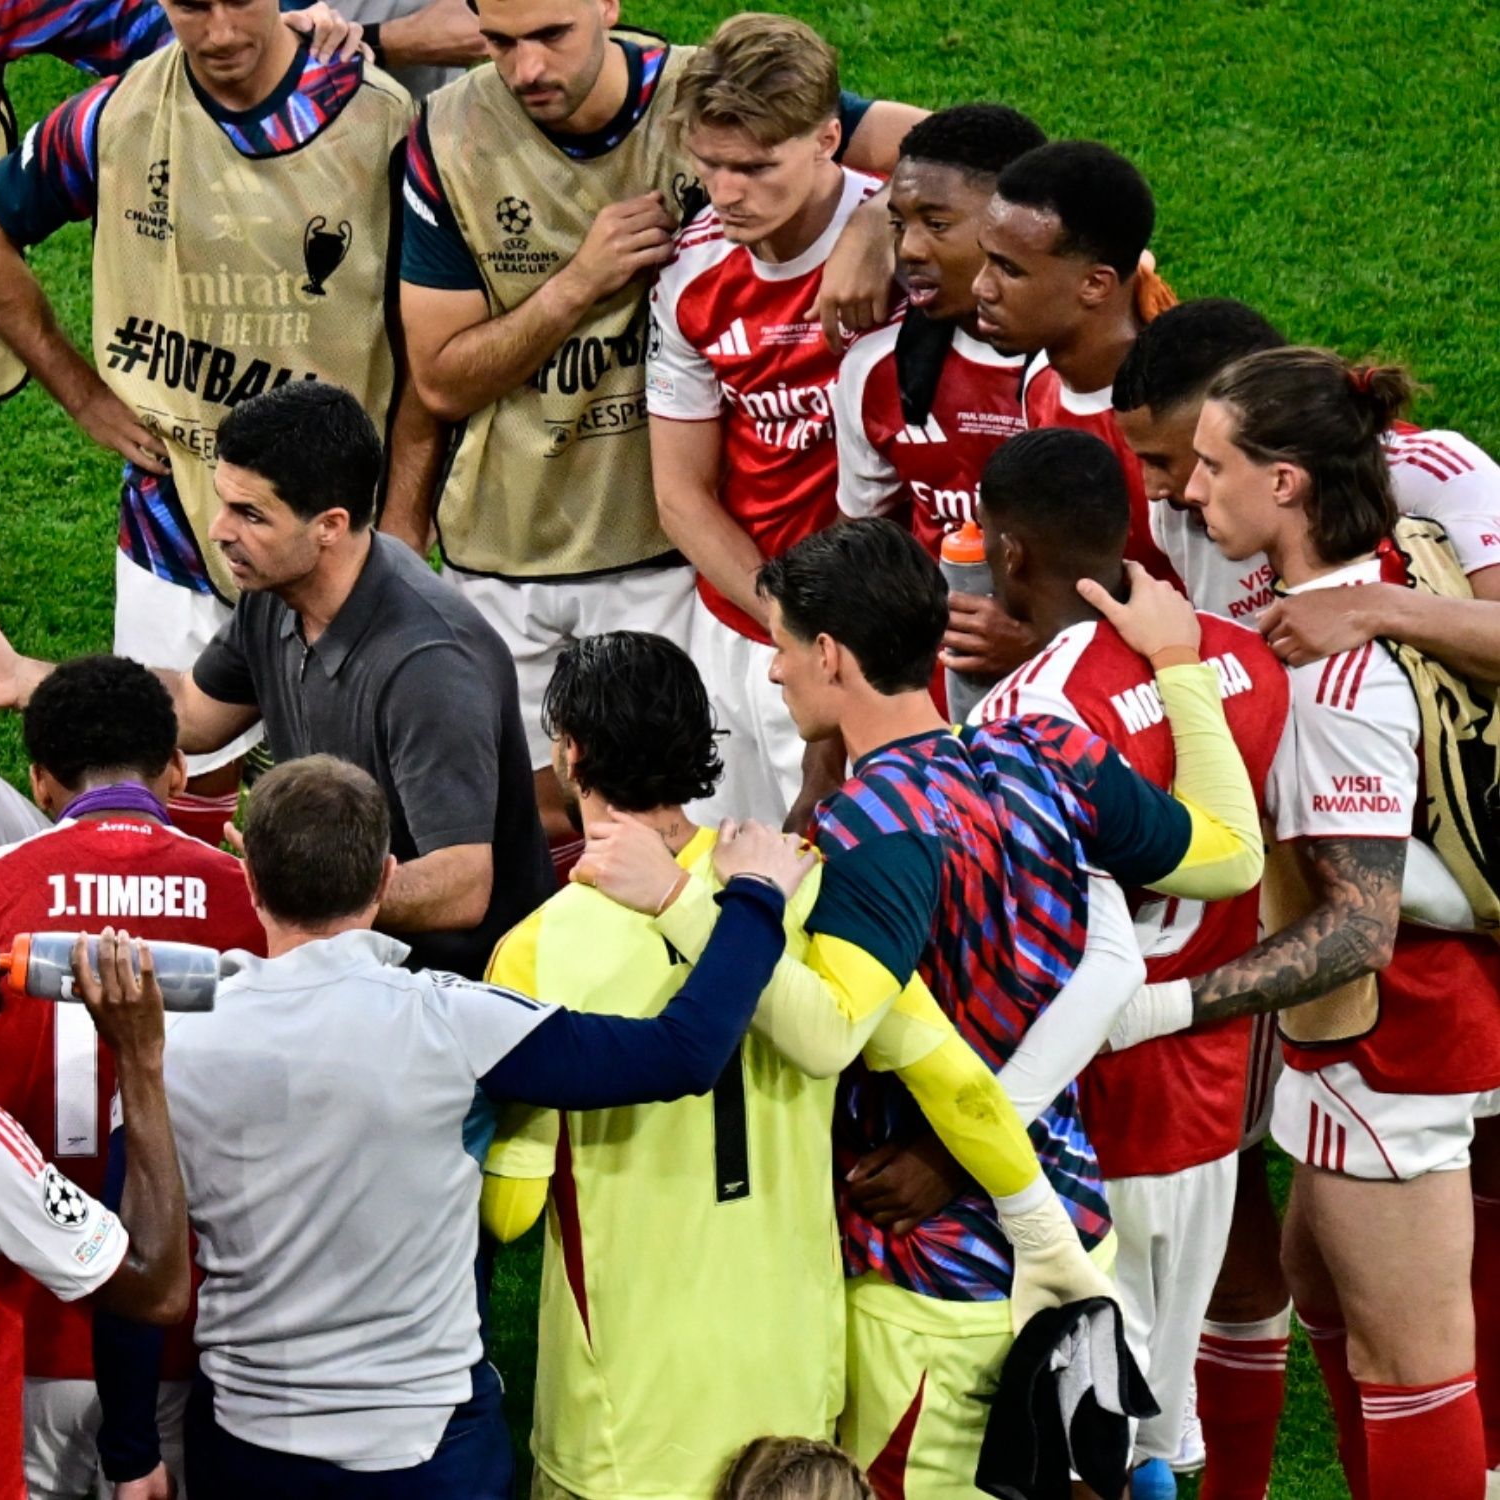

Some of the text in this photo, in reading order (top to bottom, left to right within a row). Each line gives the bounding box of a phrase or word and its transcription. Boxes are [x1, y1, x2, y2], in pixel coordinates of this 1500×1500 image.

[125, 209, 174, 232] CHAMP
[480, 251, 560, 262] CHAMPIONS
[495, 263, 548, 274] LEAGUE
[221, 312, 311, 346] BETTER
[1331, 775, 1383, 793] VISIT
[1312, 795, 1402, 813] RWANDA
[48, 873, 207, 919] J.TIMBER
